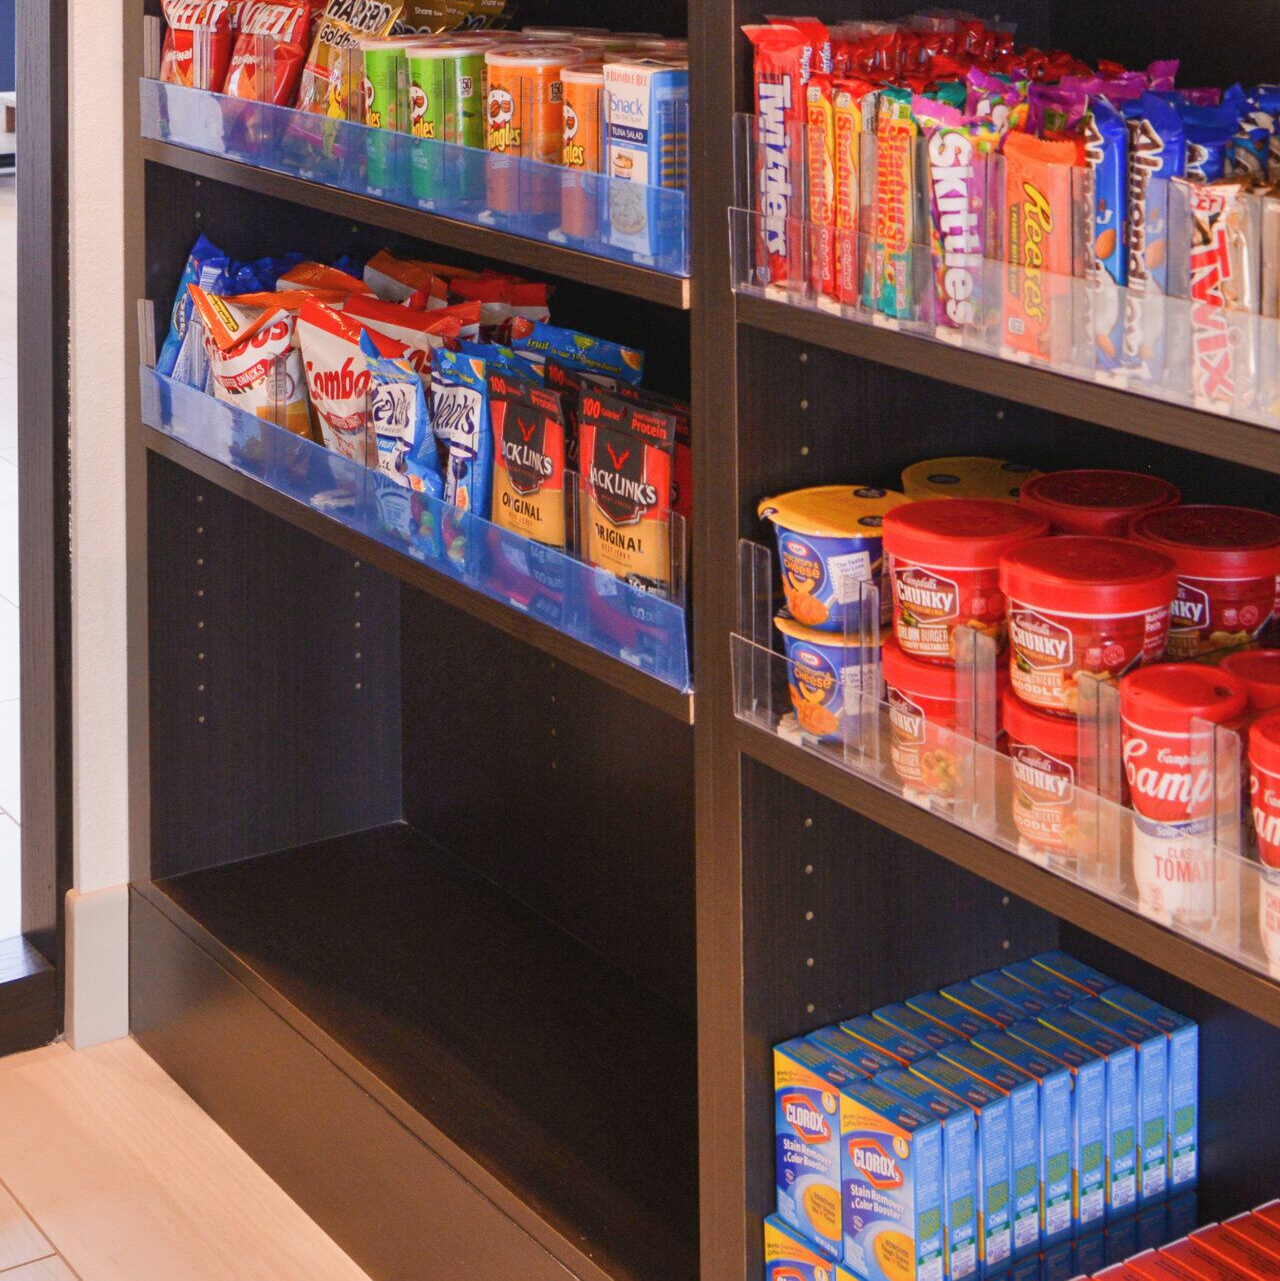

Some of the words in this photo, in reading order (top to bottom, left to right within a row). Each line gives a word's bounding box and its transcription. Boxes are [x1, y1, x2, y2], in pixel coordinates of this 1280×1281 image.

[414, 5, 433, 16] Share
[550, 82, 564, 96] 150
[609, 94, 644, 117] Snack
[611, 127, 626, 138] TUNA
[626, 129, 644, 141] SALAD
[927, 131, 983, 327] Skittles
[1023, 181, 1056, 325] Reese's
[1190, 229, 1236, 399] TWIX
[526, 338, 550, 351] Fruit
[237, 364, 266, 387] SNACKS
[490, 377, 507, 396] 100
[583, 397, 601, 419] 100
[631, 418, 668, 440] Protein
[614, 478, 658, 506] LINK'S
[896, 580, 954, 612] CHUNKY
[1011, 628, 1068, 659] CHUNKY
[783, 1138, 802, 1152] Stain
[801, 1142, 833, 1167] Remover
[787, 1151, 804, 1166] Color
[803, 1156, 829, 1172] Booster
[850, 1183, 871, 1199] Stain
[870, 1188, 905, 1212] Remover
[855, 1197, 873, 1211] Color
[873, 1202, 901, 1221] Booster
